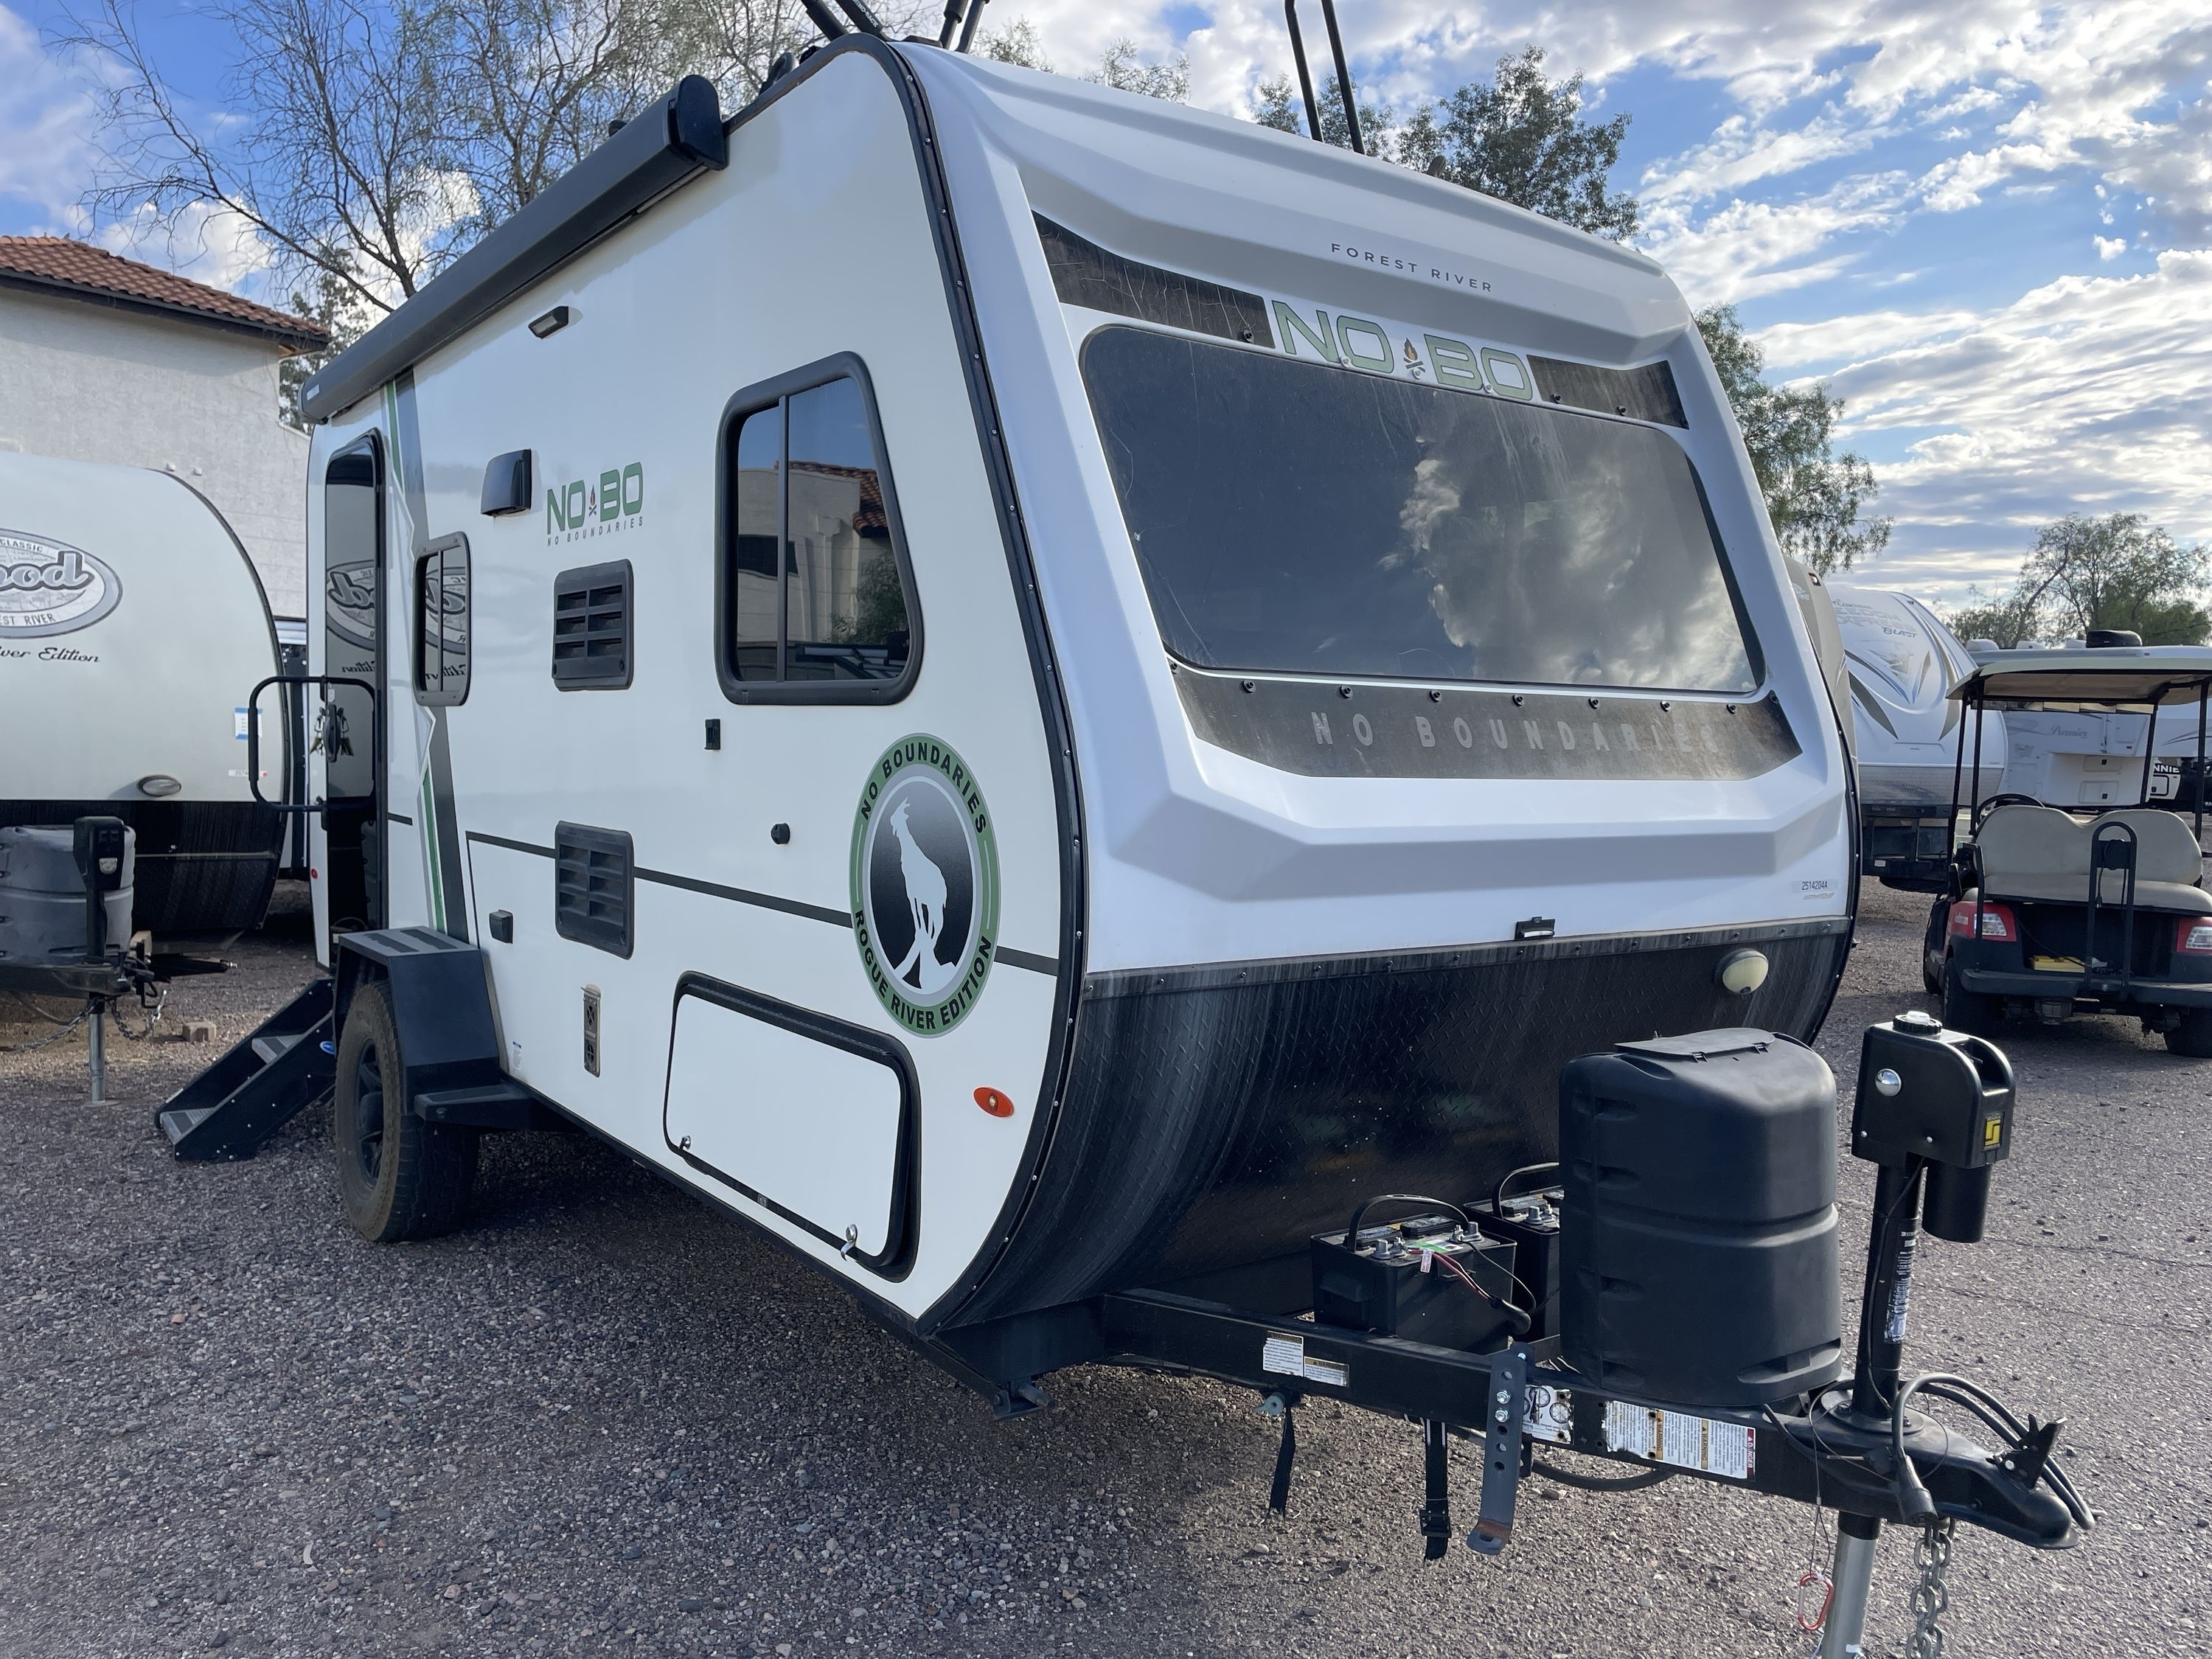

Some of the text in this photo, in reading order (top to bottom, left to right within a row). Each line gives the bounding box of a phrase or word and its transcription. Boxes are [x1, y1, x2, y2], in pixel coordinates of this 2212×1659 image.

[1331, 243, 1492, 292] FOREST RIVER
[1271, 300, 1532, 400] NO BO
[547, 462, 643, 535] NO BO
[547, 516, 643, 547] NO BOUNDARIES
[24, 613, 56, 625] RIVER
[1882, 627, 1917, 638] BLAST
[38, 647, 100, 663] Edition
[1311, 712, 1718, 753] NO BOUNDARIES
[861, 742, 987, 834] NO BOUNDARIES
[855, 911, 992, 1030] ROGUE RIVER EDITION
